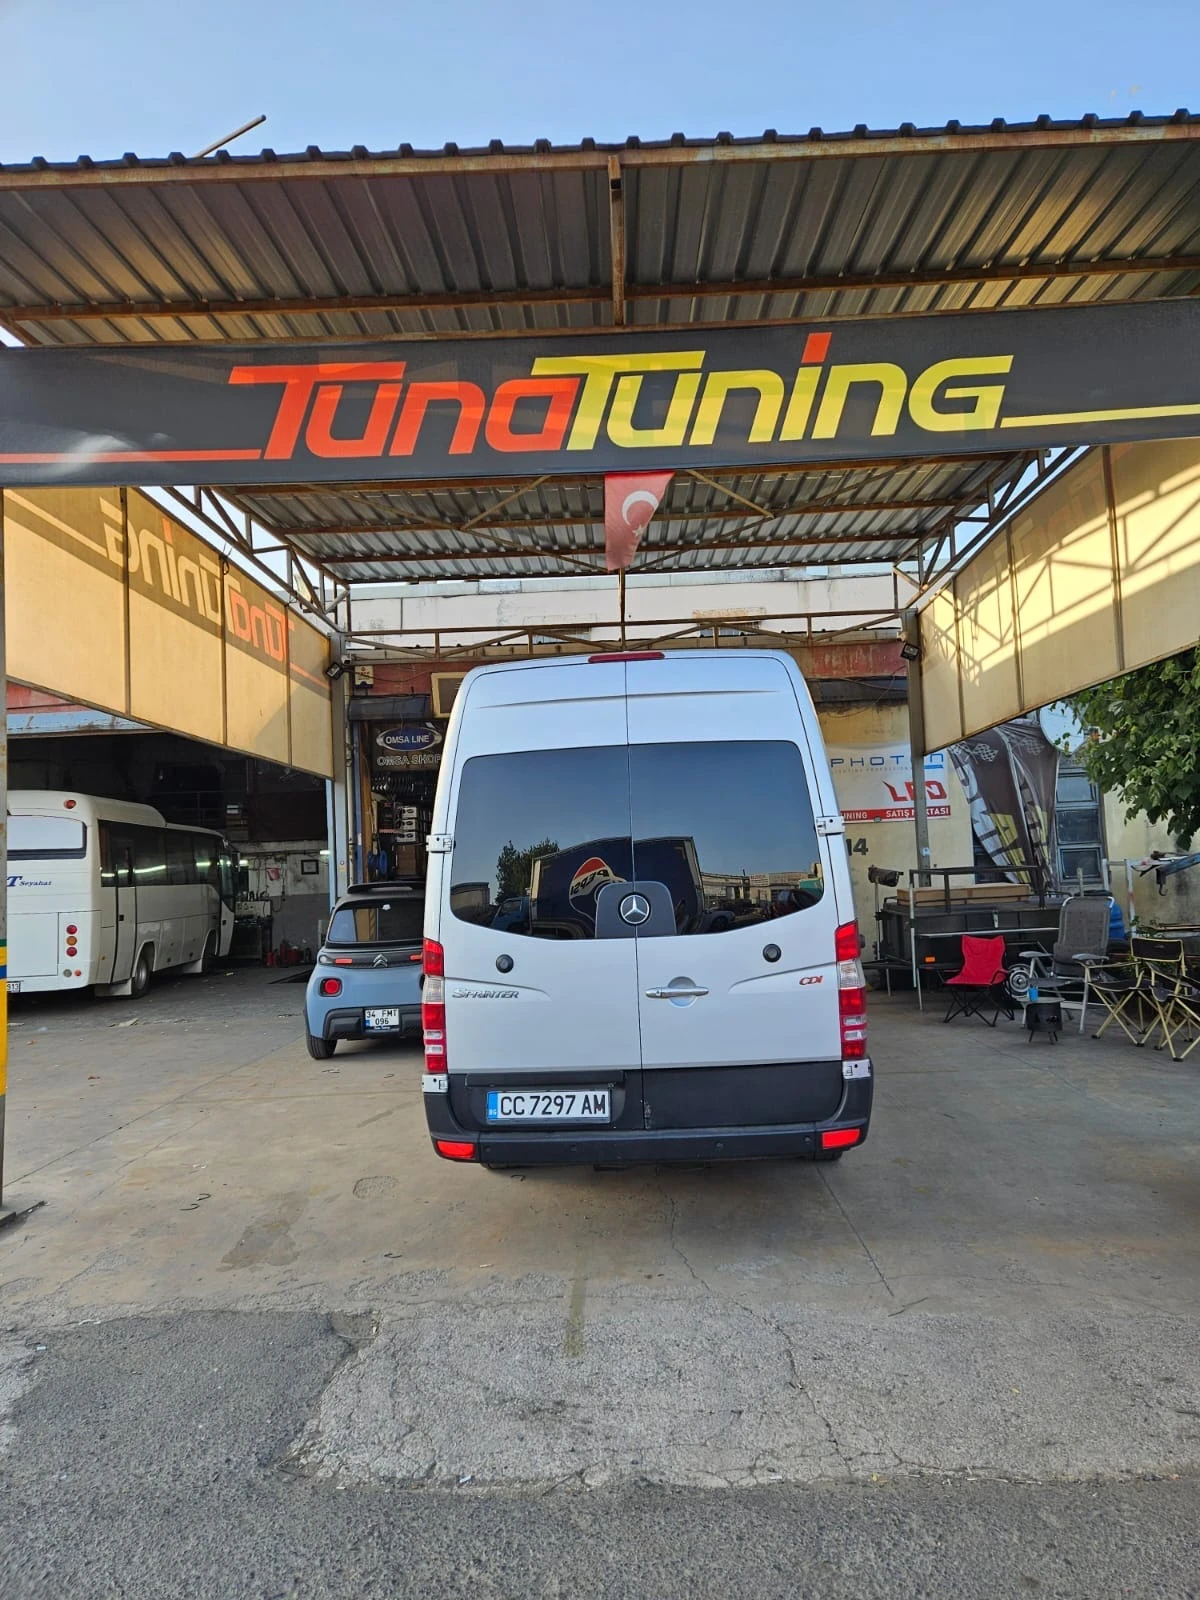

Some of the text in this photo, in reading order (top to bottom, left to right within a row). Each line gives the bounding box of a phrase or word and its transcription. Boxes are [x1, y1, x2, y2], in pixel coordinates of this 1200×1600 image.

[385, 734, 430, 744] OMSA LINE
[377, 755, 410, 766] OMSA
[830, 752, 944, 768] PHOTN
[886, 809, 910, 818] SATIŞ
[382, 1009, 397, 1017] FMT
[375, 1017, 389, 1025] 096
